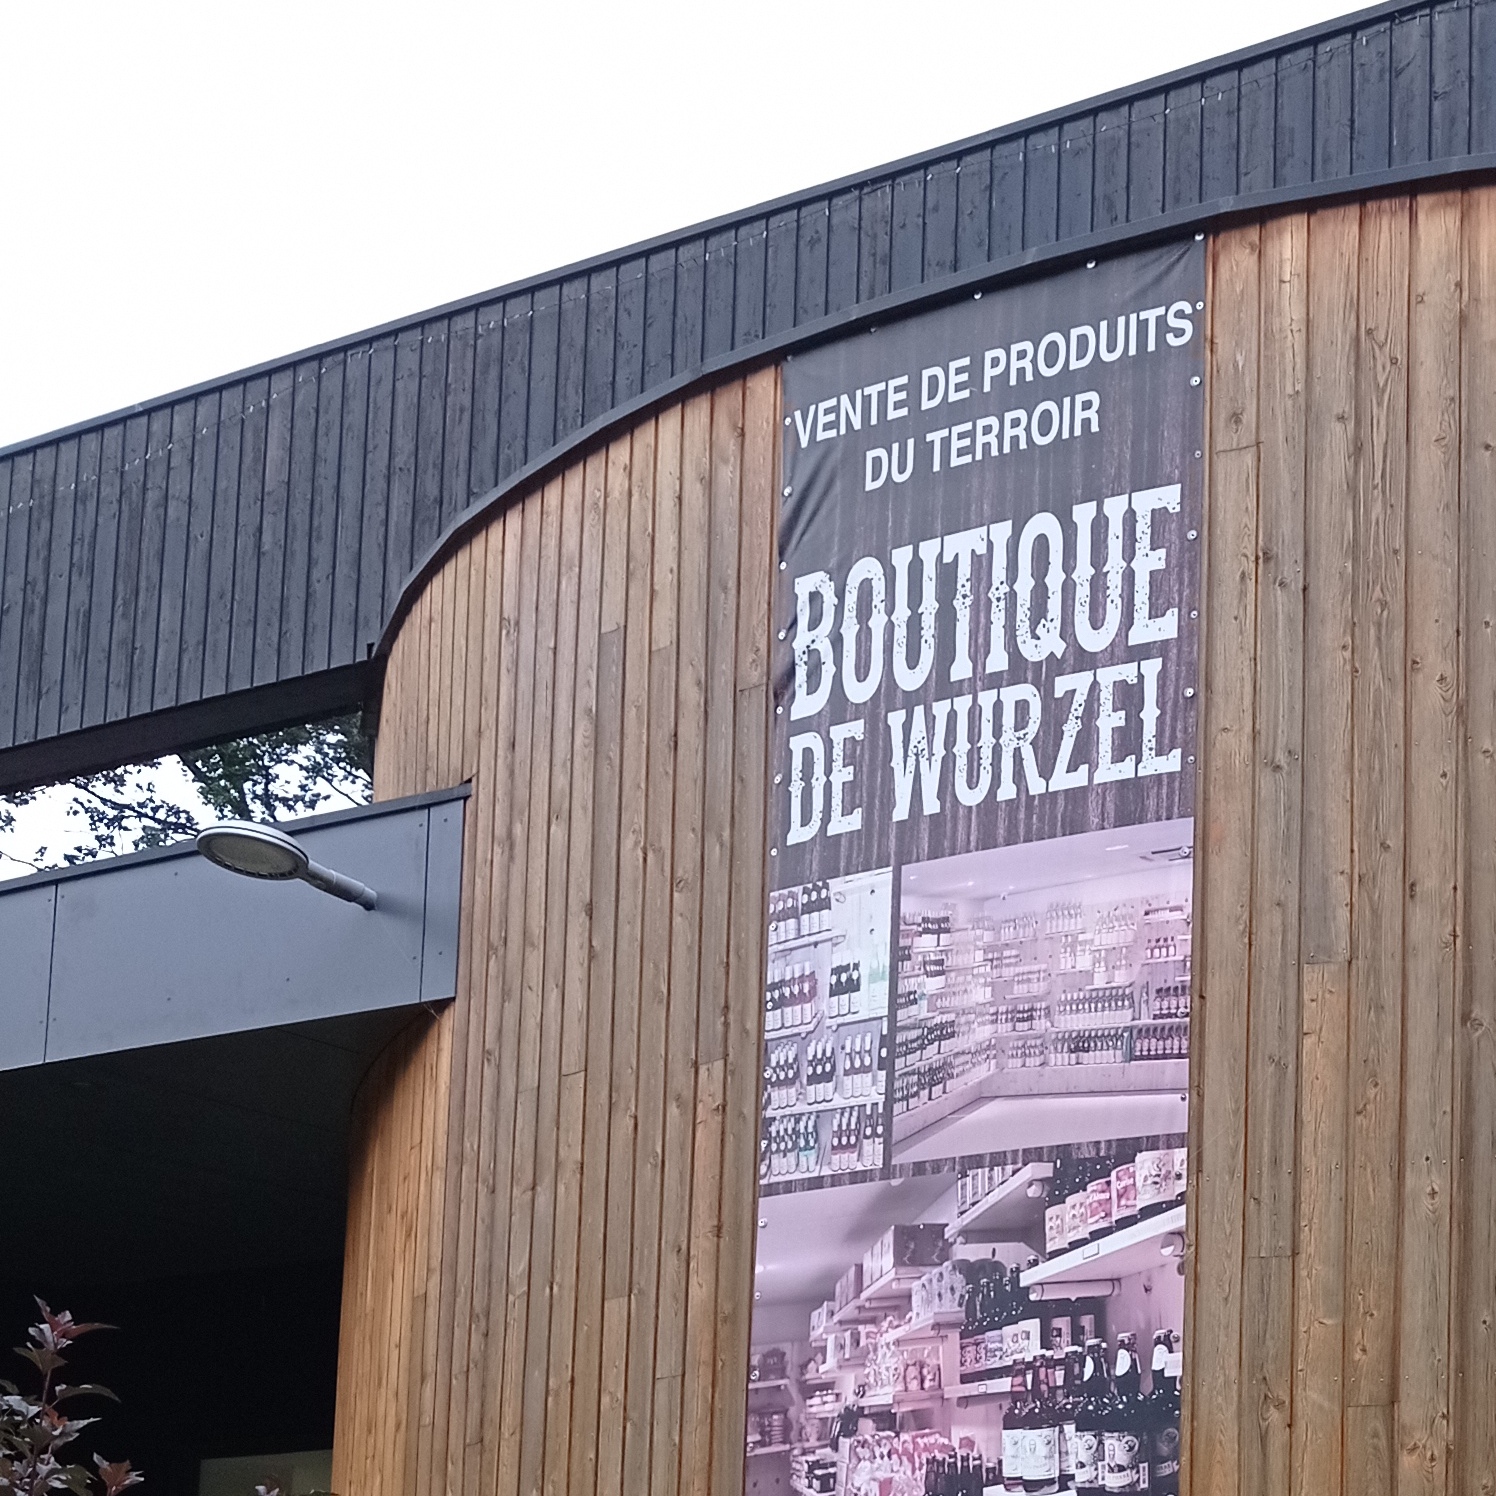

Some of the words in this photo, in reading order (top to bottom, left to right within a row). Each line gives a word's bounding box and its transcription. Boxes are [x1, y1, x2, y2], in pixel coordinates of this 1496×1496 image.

[794, 375, 909, 449] VENTE
[921, 357, 971, 411] DE
[983, 301, 1194, 392] PRODUITS
[865, 438, 915, 492] DU
[926, 391, 1100, 473] TERROIR
[791, 483, 1182, 721] BOUTIQUE
[786, 719, 864, 846] DE
[887, 658, 1182, 822] WURZEL
